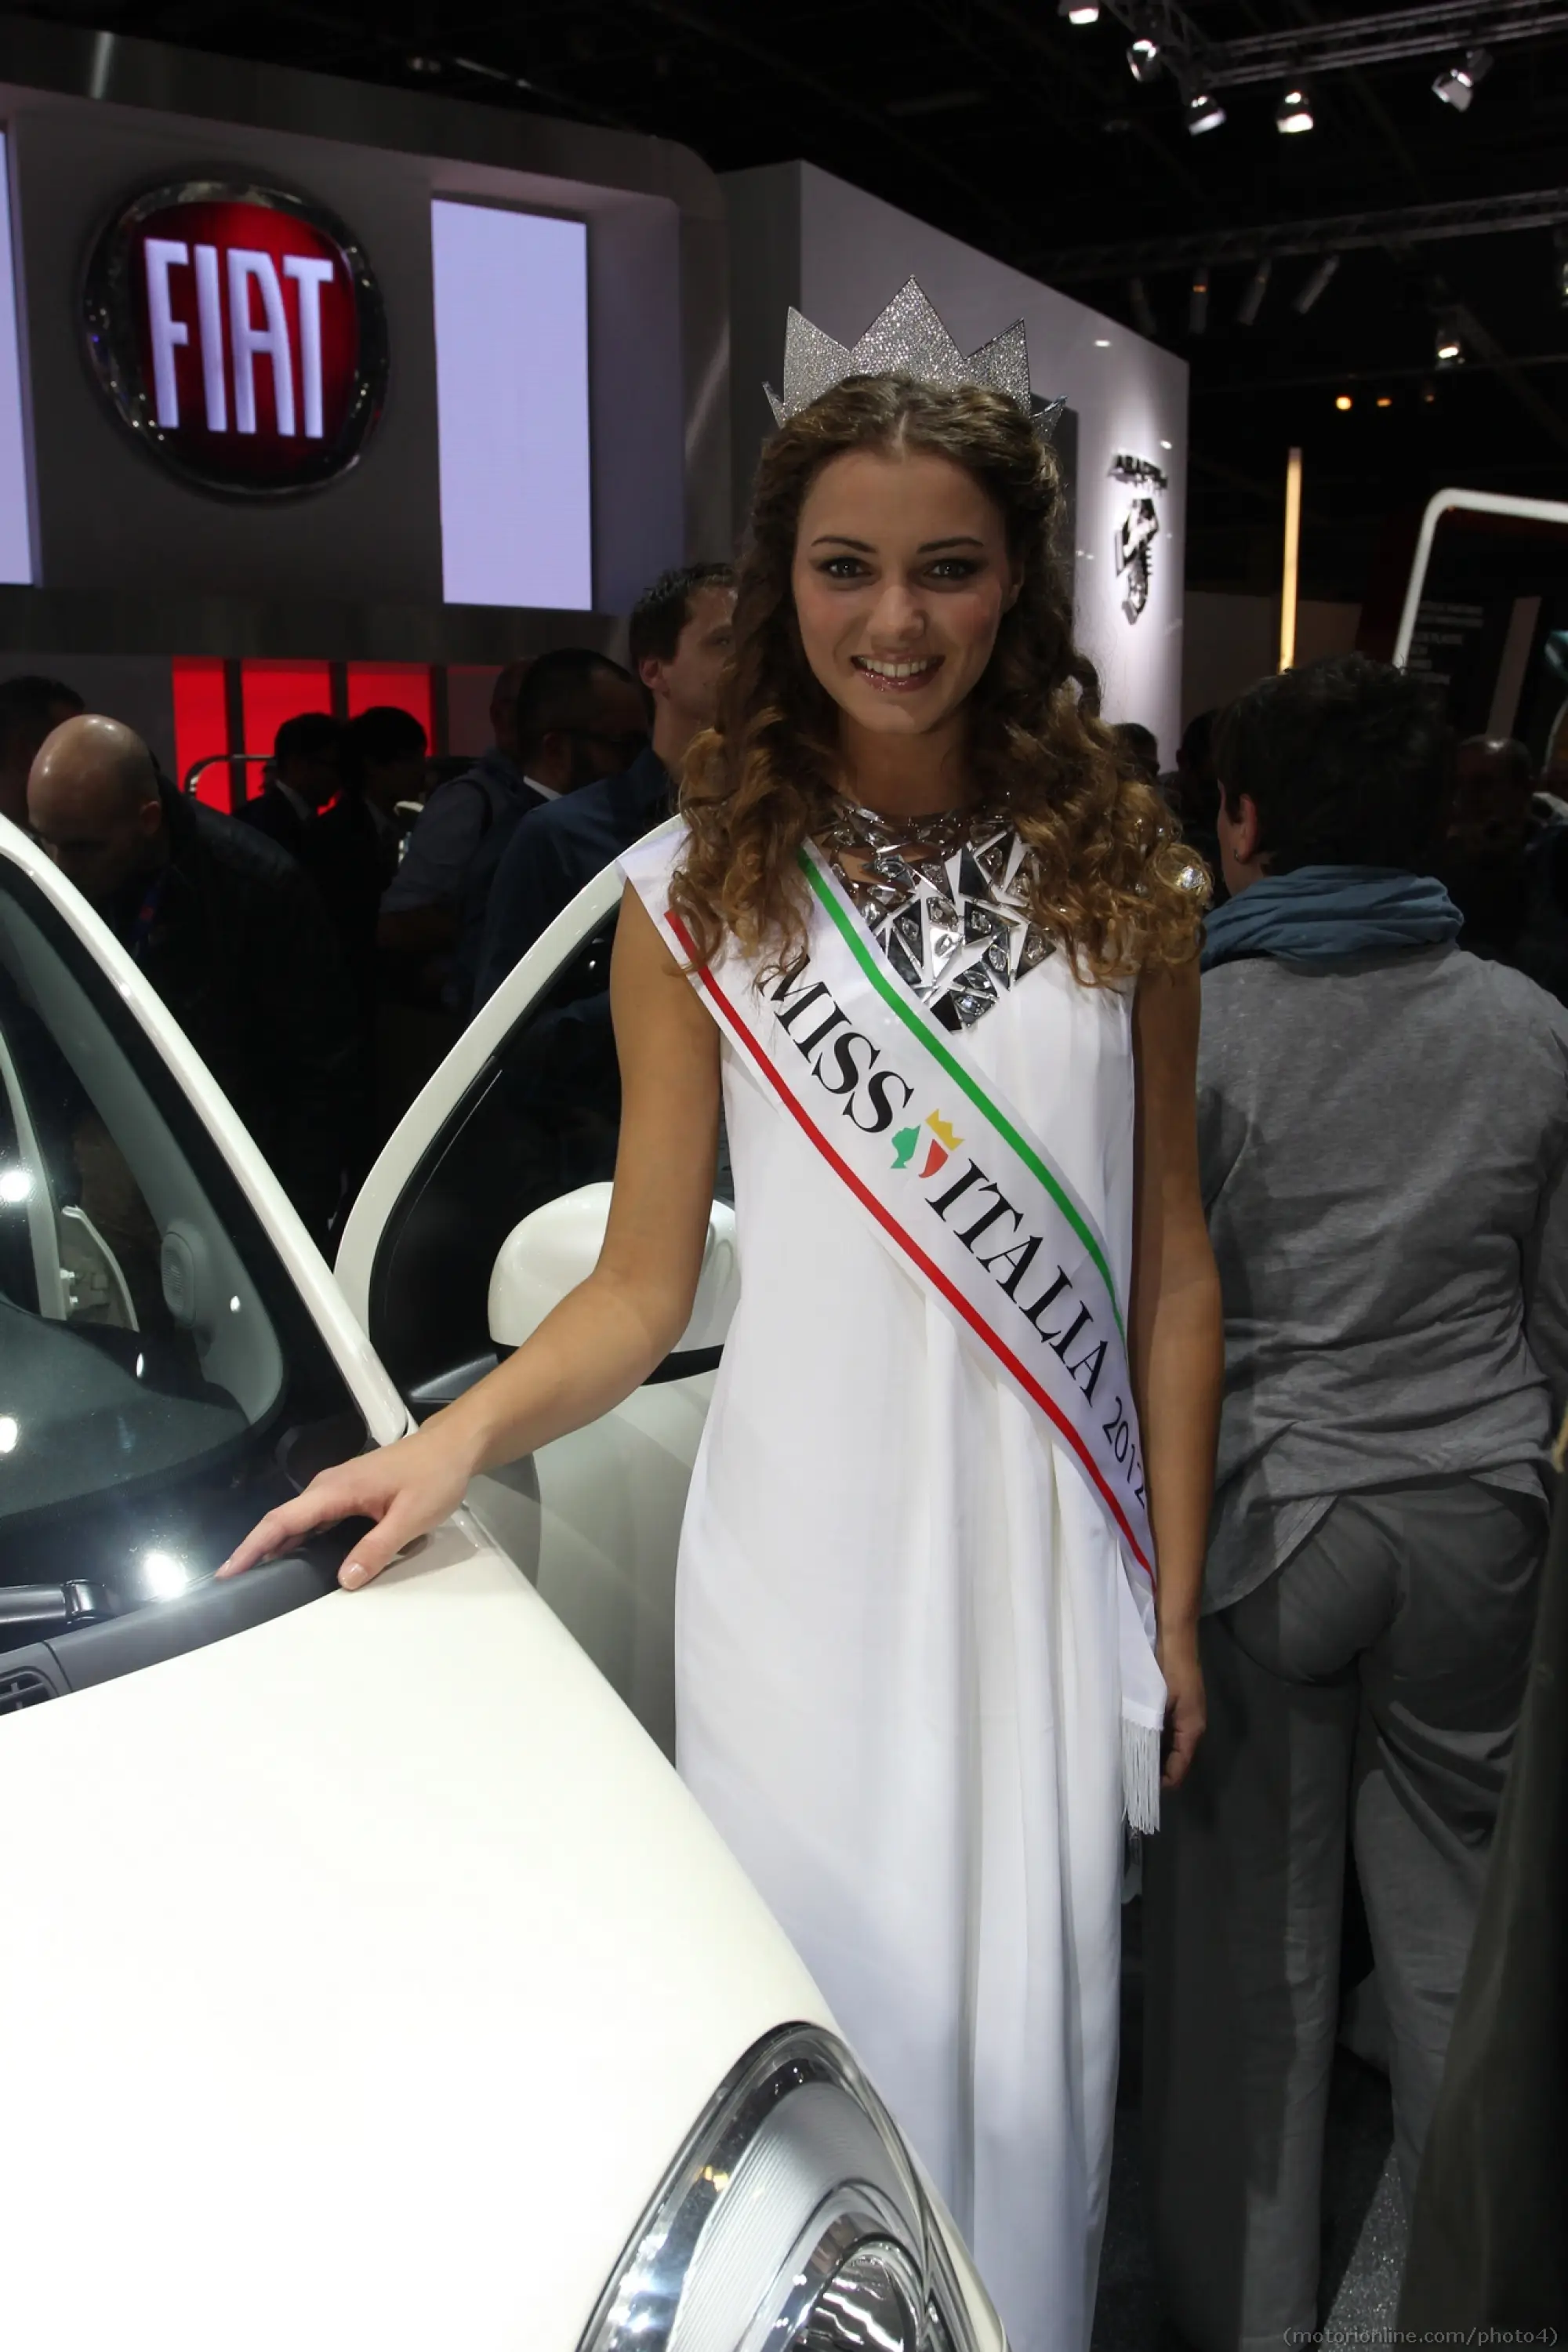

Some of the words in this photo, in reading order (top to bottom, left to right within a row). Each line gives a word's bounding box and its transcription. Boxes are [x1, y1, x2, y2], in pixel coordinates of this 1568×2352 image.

[144, 238, 333, 438] FIAT
[758, 953, 914, 1134] MISS
[924, 1158, 1109, 1408] ITALIA
[1102, 1396, 1145, 1510] 2012
